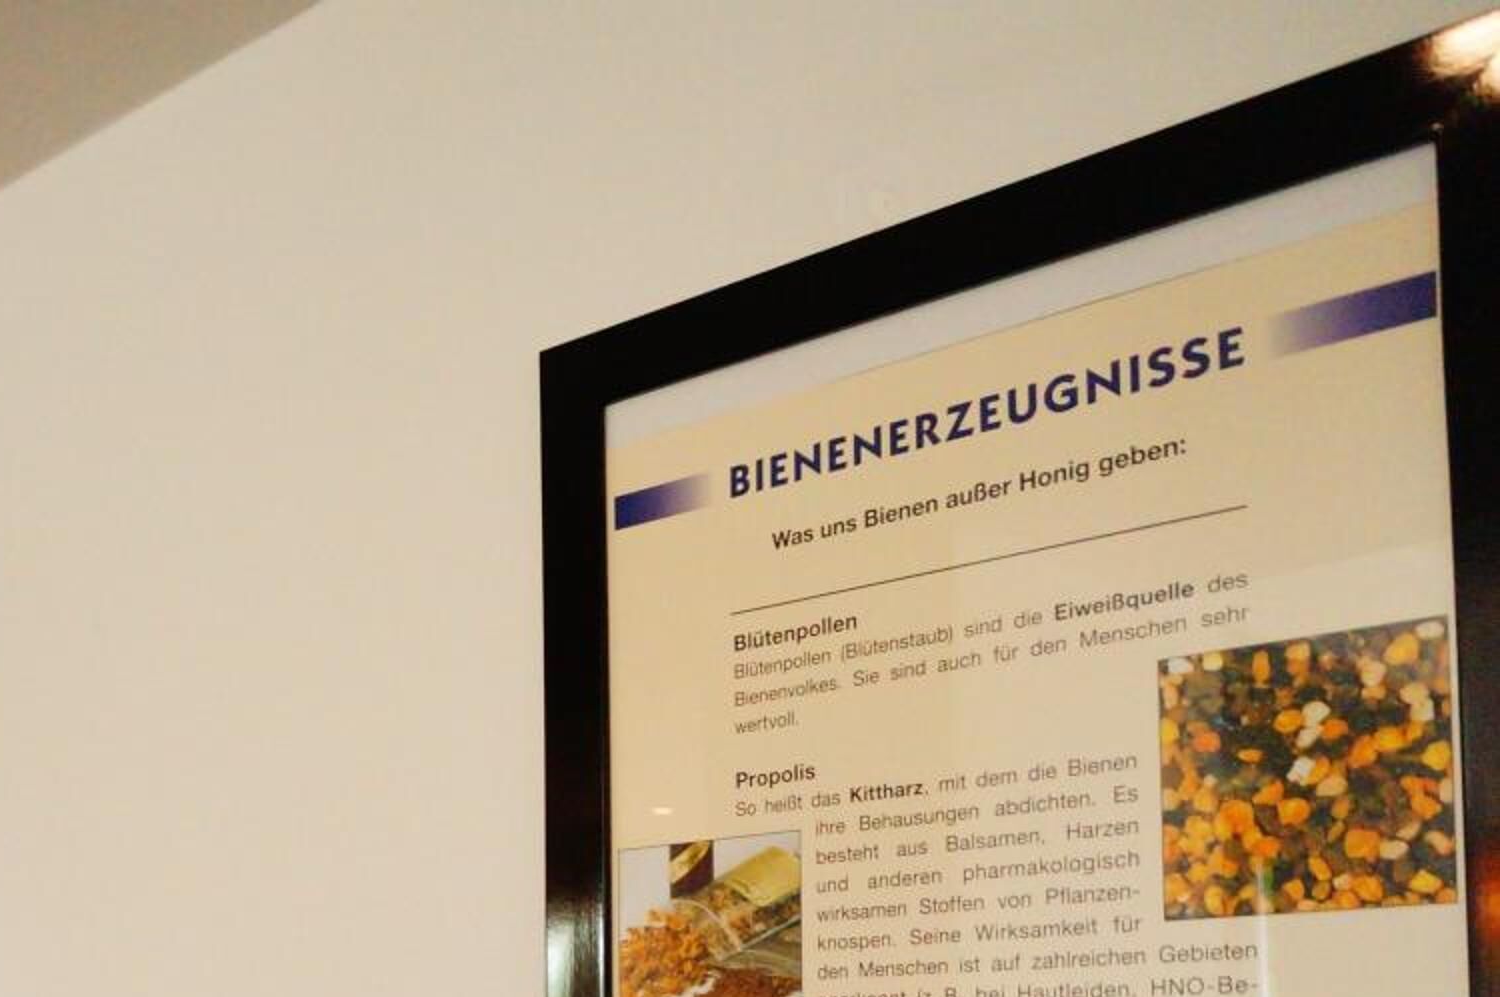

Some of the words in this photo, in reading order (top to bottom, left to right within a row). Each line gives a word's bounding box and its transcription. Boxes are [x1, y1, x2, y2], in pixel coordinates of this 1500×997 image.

[729, 326, 1245, 499] BIENENERZEUGNISSE
[771, 528, 814, 550] Was
[820, 517, 858, 539] uns
[863, 498, 939, 529] Bienen
[945, 479, 1013, 509] außer
[1019, 460, 1090, 492] Honig
[1098, 439, 1186, 478] geben:
[733, 650, 832, 680] Blütenpollen
[839, 624, 954, 665] (Blütenstaub)
[963, 615, 1003, 639] sind
[1013, 611, 1043, 630] die
[1054, 581, 1195, 622] Eiweißquelle
[1206, 573, 1249, 593] des
[733, 615, 858, 653] Blütenpollen
[733, 677, 842, 708] Bienenvolkes.
[852, 669, 880, 687] Sie
[889, 659, 928, 681] sind
[936, 651, 982, 673] auch
[992, 644, 1020, 664] für
[1029, 638, 1068, 657] den
[1079, 617, 1187, 649] Menschen
[1200, 605, 1250, 628] sehr
[734, 710, 799, 735] wertvoll.
[734, 800, 758, 817] So
[764, 793, 803, 814] heißt
[810, 791, 842, 809] das
[849, 783, 929, 803] Kittharz,
[938, 775, 967, 793] mit
[974, 770, 1018, 789] dem
[1027, 763, 1058, 783] die
[1067, 755, 1138, 777] Bienen
[735, 763, 816, 789] Propolis
[815, 814, 847, 837] ihre
[858, 805, 980, 832] Behausungen
[994, 792, 1096, 817] abdichten.
[1112, 784, 1139, 805] Es
[815, 843, 880, 865] besteht
[895, 840, 929, 858] aus
[944, 831, 1045, 853] Balsamen,
[1066, 820, 1139, 841] Harzen
[816, 874, 850, 894] und
[867, 870, 943, 890] anderen
[962, 849, 1141, 886] pharmakologisch
[816, 903, 908, 923] wirksamen
[918, 895, 985, 915] Stoffen
[996, 893, 1032, 910] von
[1045, 885, 1141, 905] Pflanzen-
[817, 933, 897, 953] knospen.
[908, 927, 962, 946] Seine
[973, 917, 1098, 942] Wirksamkeit
[1112, 915, 1142, 934] für
[816, 963, 849, 981] den
[858, 959, 949, 977] Menschen
[959, 956, 981, 974] ist
[990, 952, 1021, 973] auf
[1030, 947, 1147, 971] zahlreichen
[1158, 943, 1258, 964] Gebieten
[1150, 975, 1257, 997] HNO-Be-
